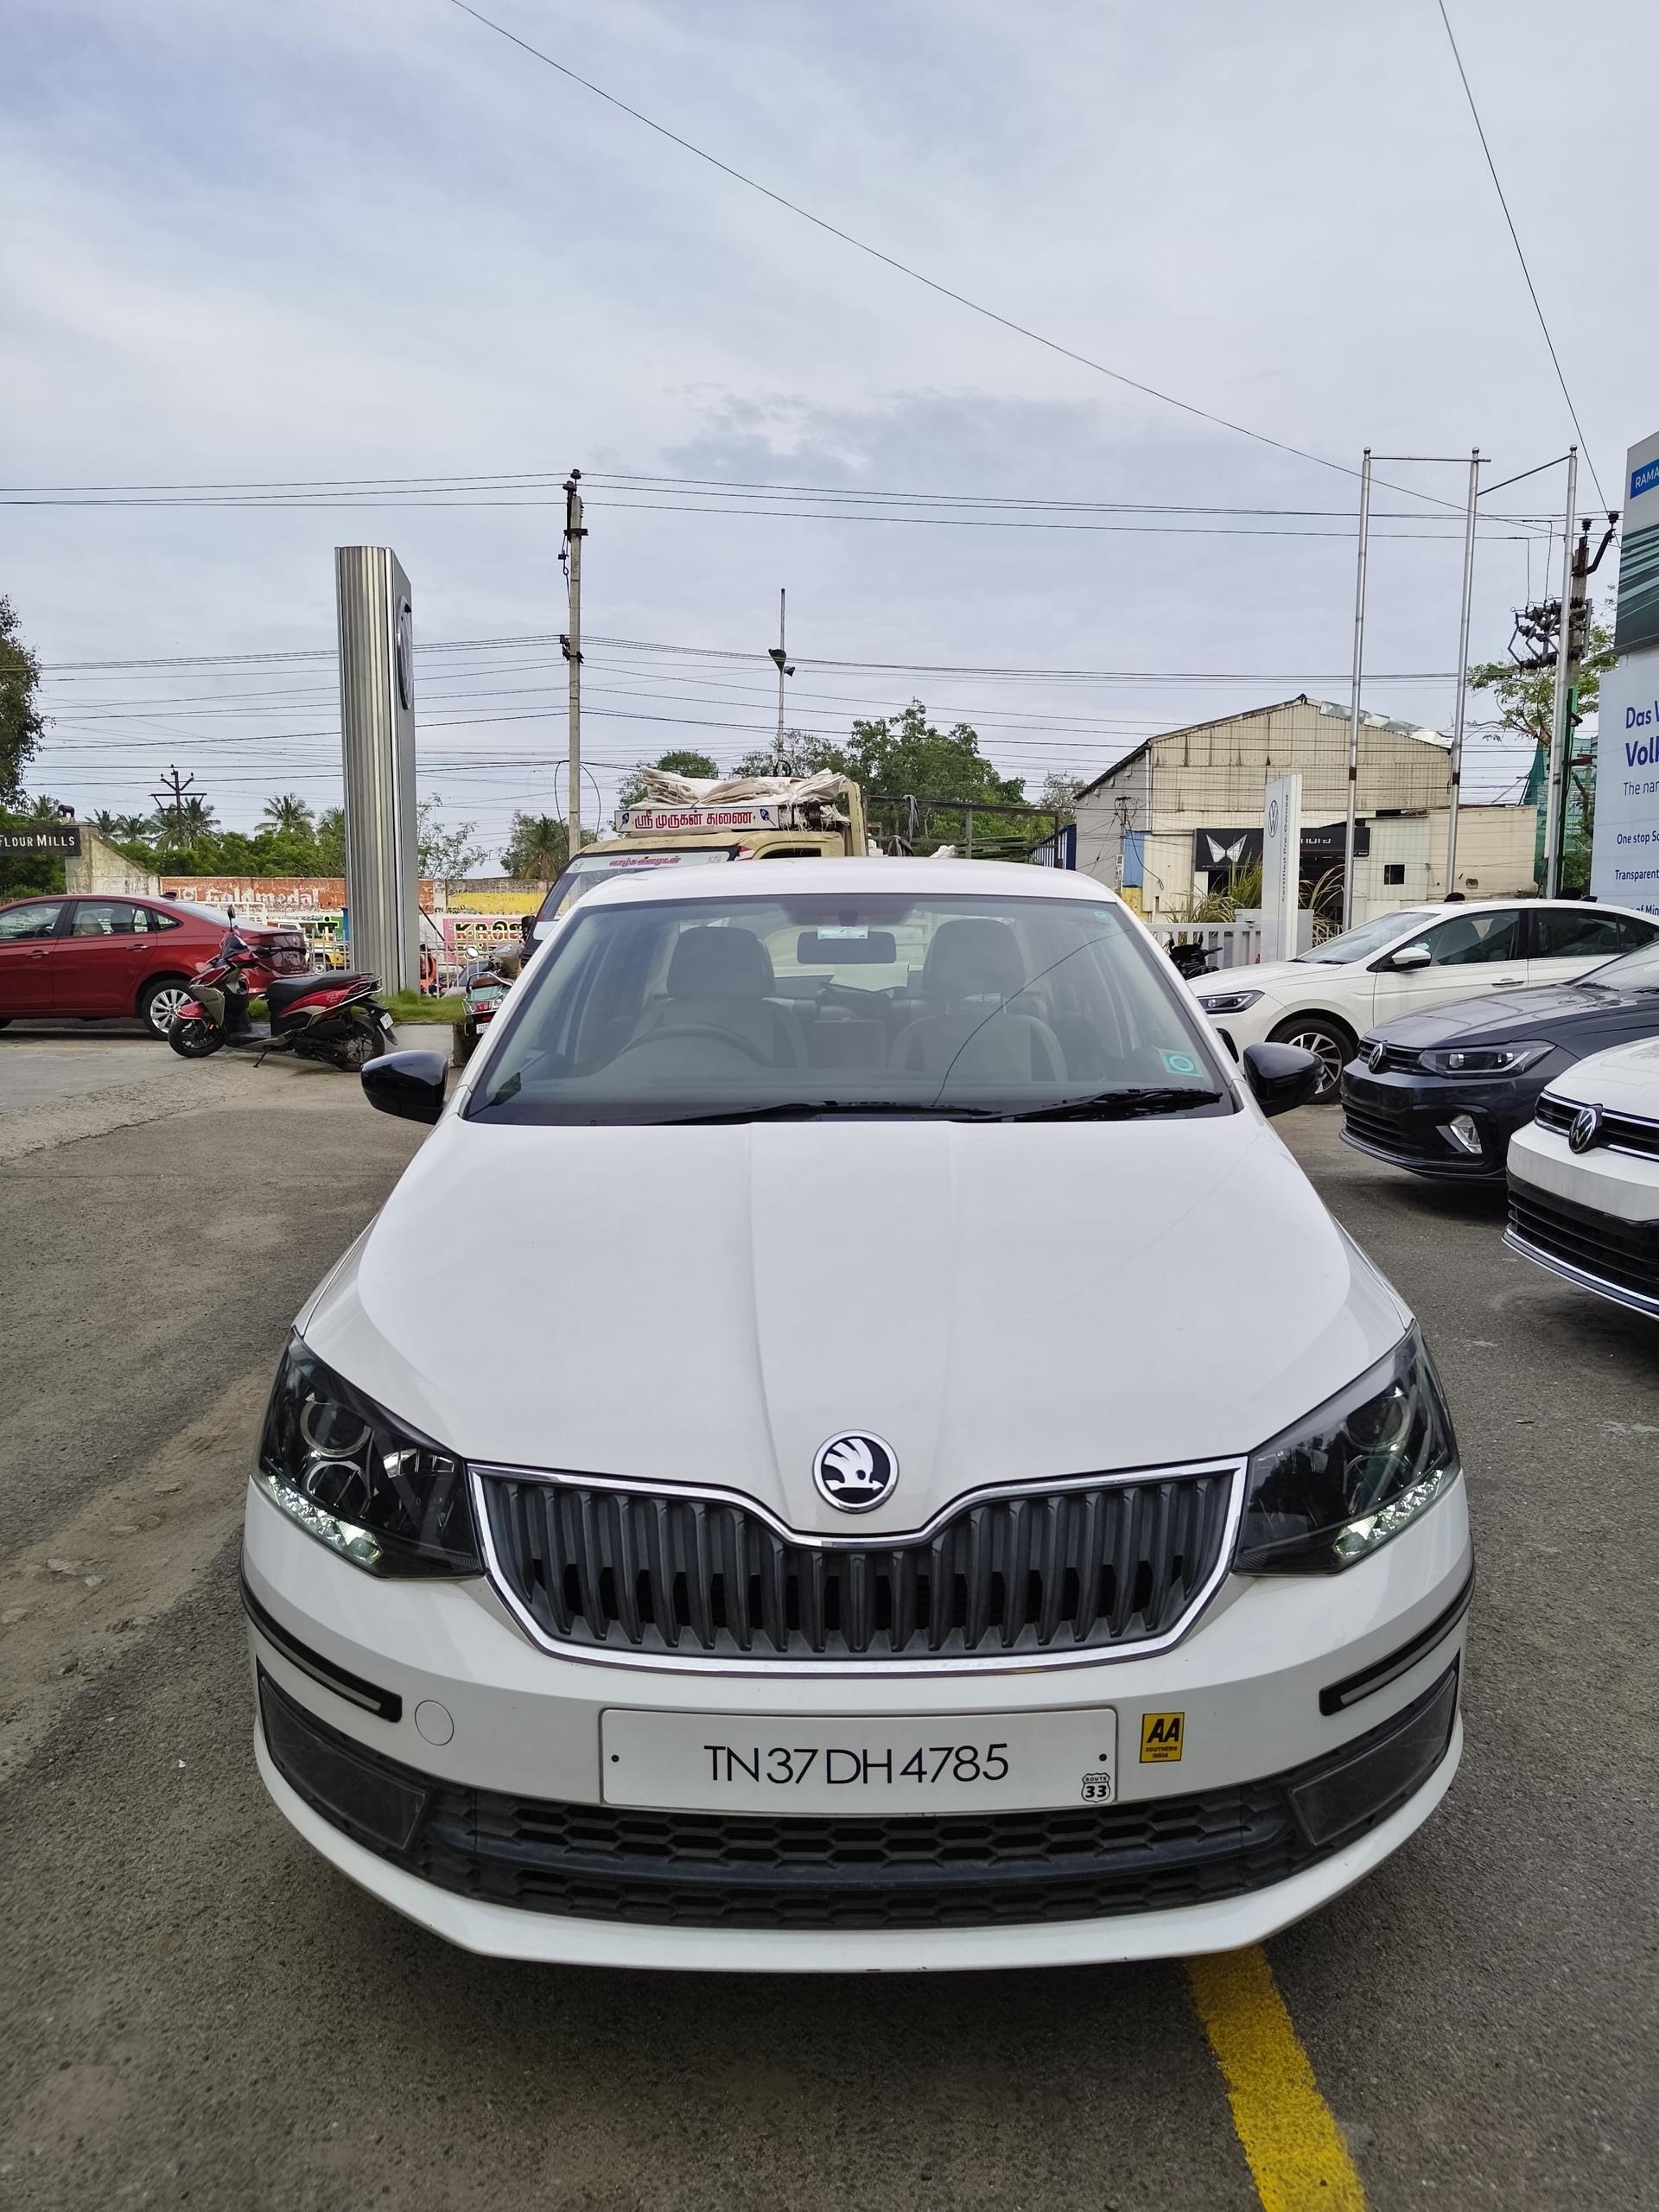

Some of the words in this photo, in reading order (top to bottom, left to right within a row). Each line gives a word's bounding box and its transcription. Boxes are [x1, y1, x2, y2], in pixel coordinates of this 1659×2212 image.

[1625, 707, 1651, 729] Das
[1624, 781, 1640, 796] The
[656, 810, 702, 829] முருகன்
[706, 811, 753, 826] துணை
[36, 835, 74, 847] MILLS
[1617, 834, 1631, 844] One
[1633, 833, 1649, 845] stop
[1146, 1718, 1180, 1744] AA
[1085, 1785, 1107, 1798] 33
